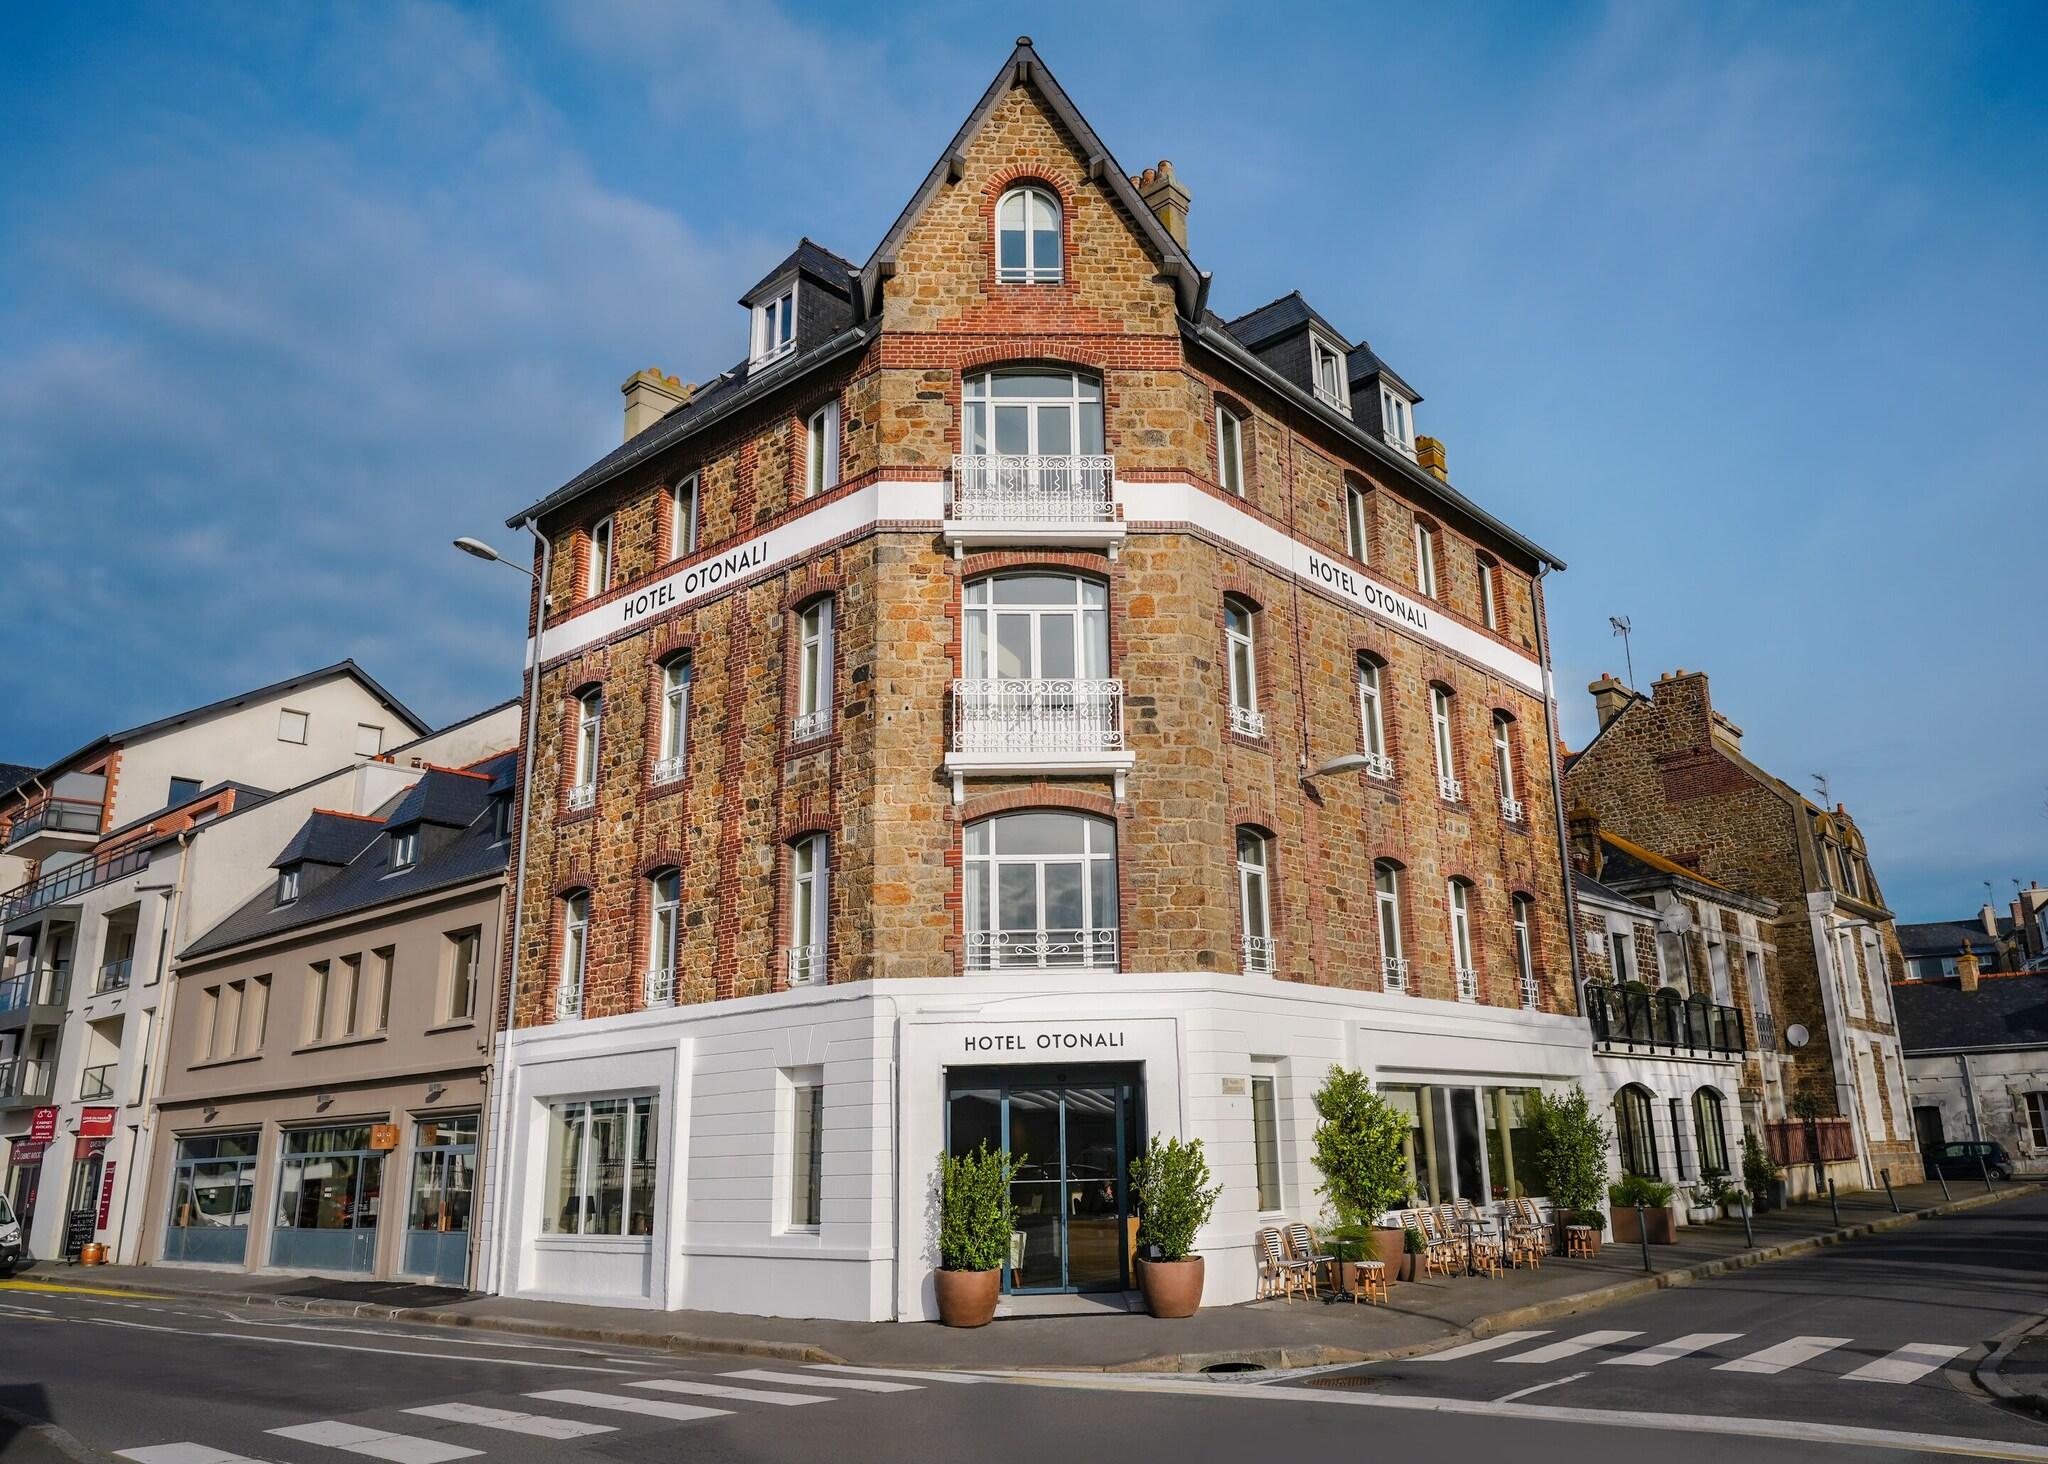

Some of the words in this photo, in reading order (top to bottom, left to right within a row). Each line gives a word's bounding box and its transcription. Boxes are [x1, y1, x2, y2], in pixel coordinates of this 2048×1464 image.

[624, 583, 675, 620] HOTEL
[685, 541, 767, 593] OTONALI
[1309, 555, 1358, 596] HOTEL
[1364, 584, 1428, 630] OTONALI
[965, 1035, 1026, 1051] HOTEL
[1036, 1032, 1124, 1048] OTONALI
